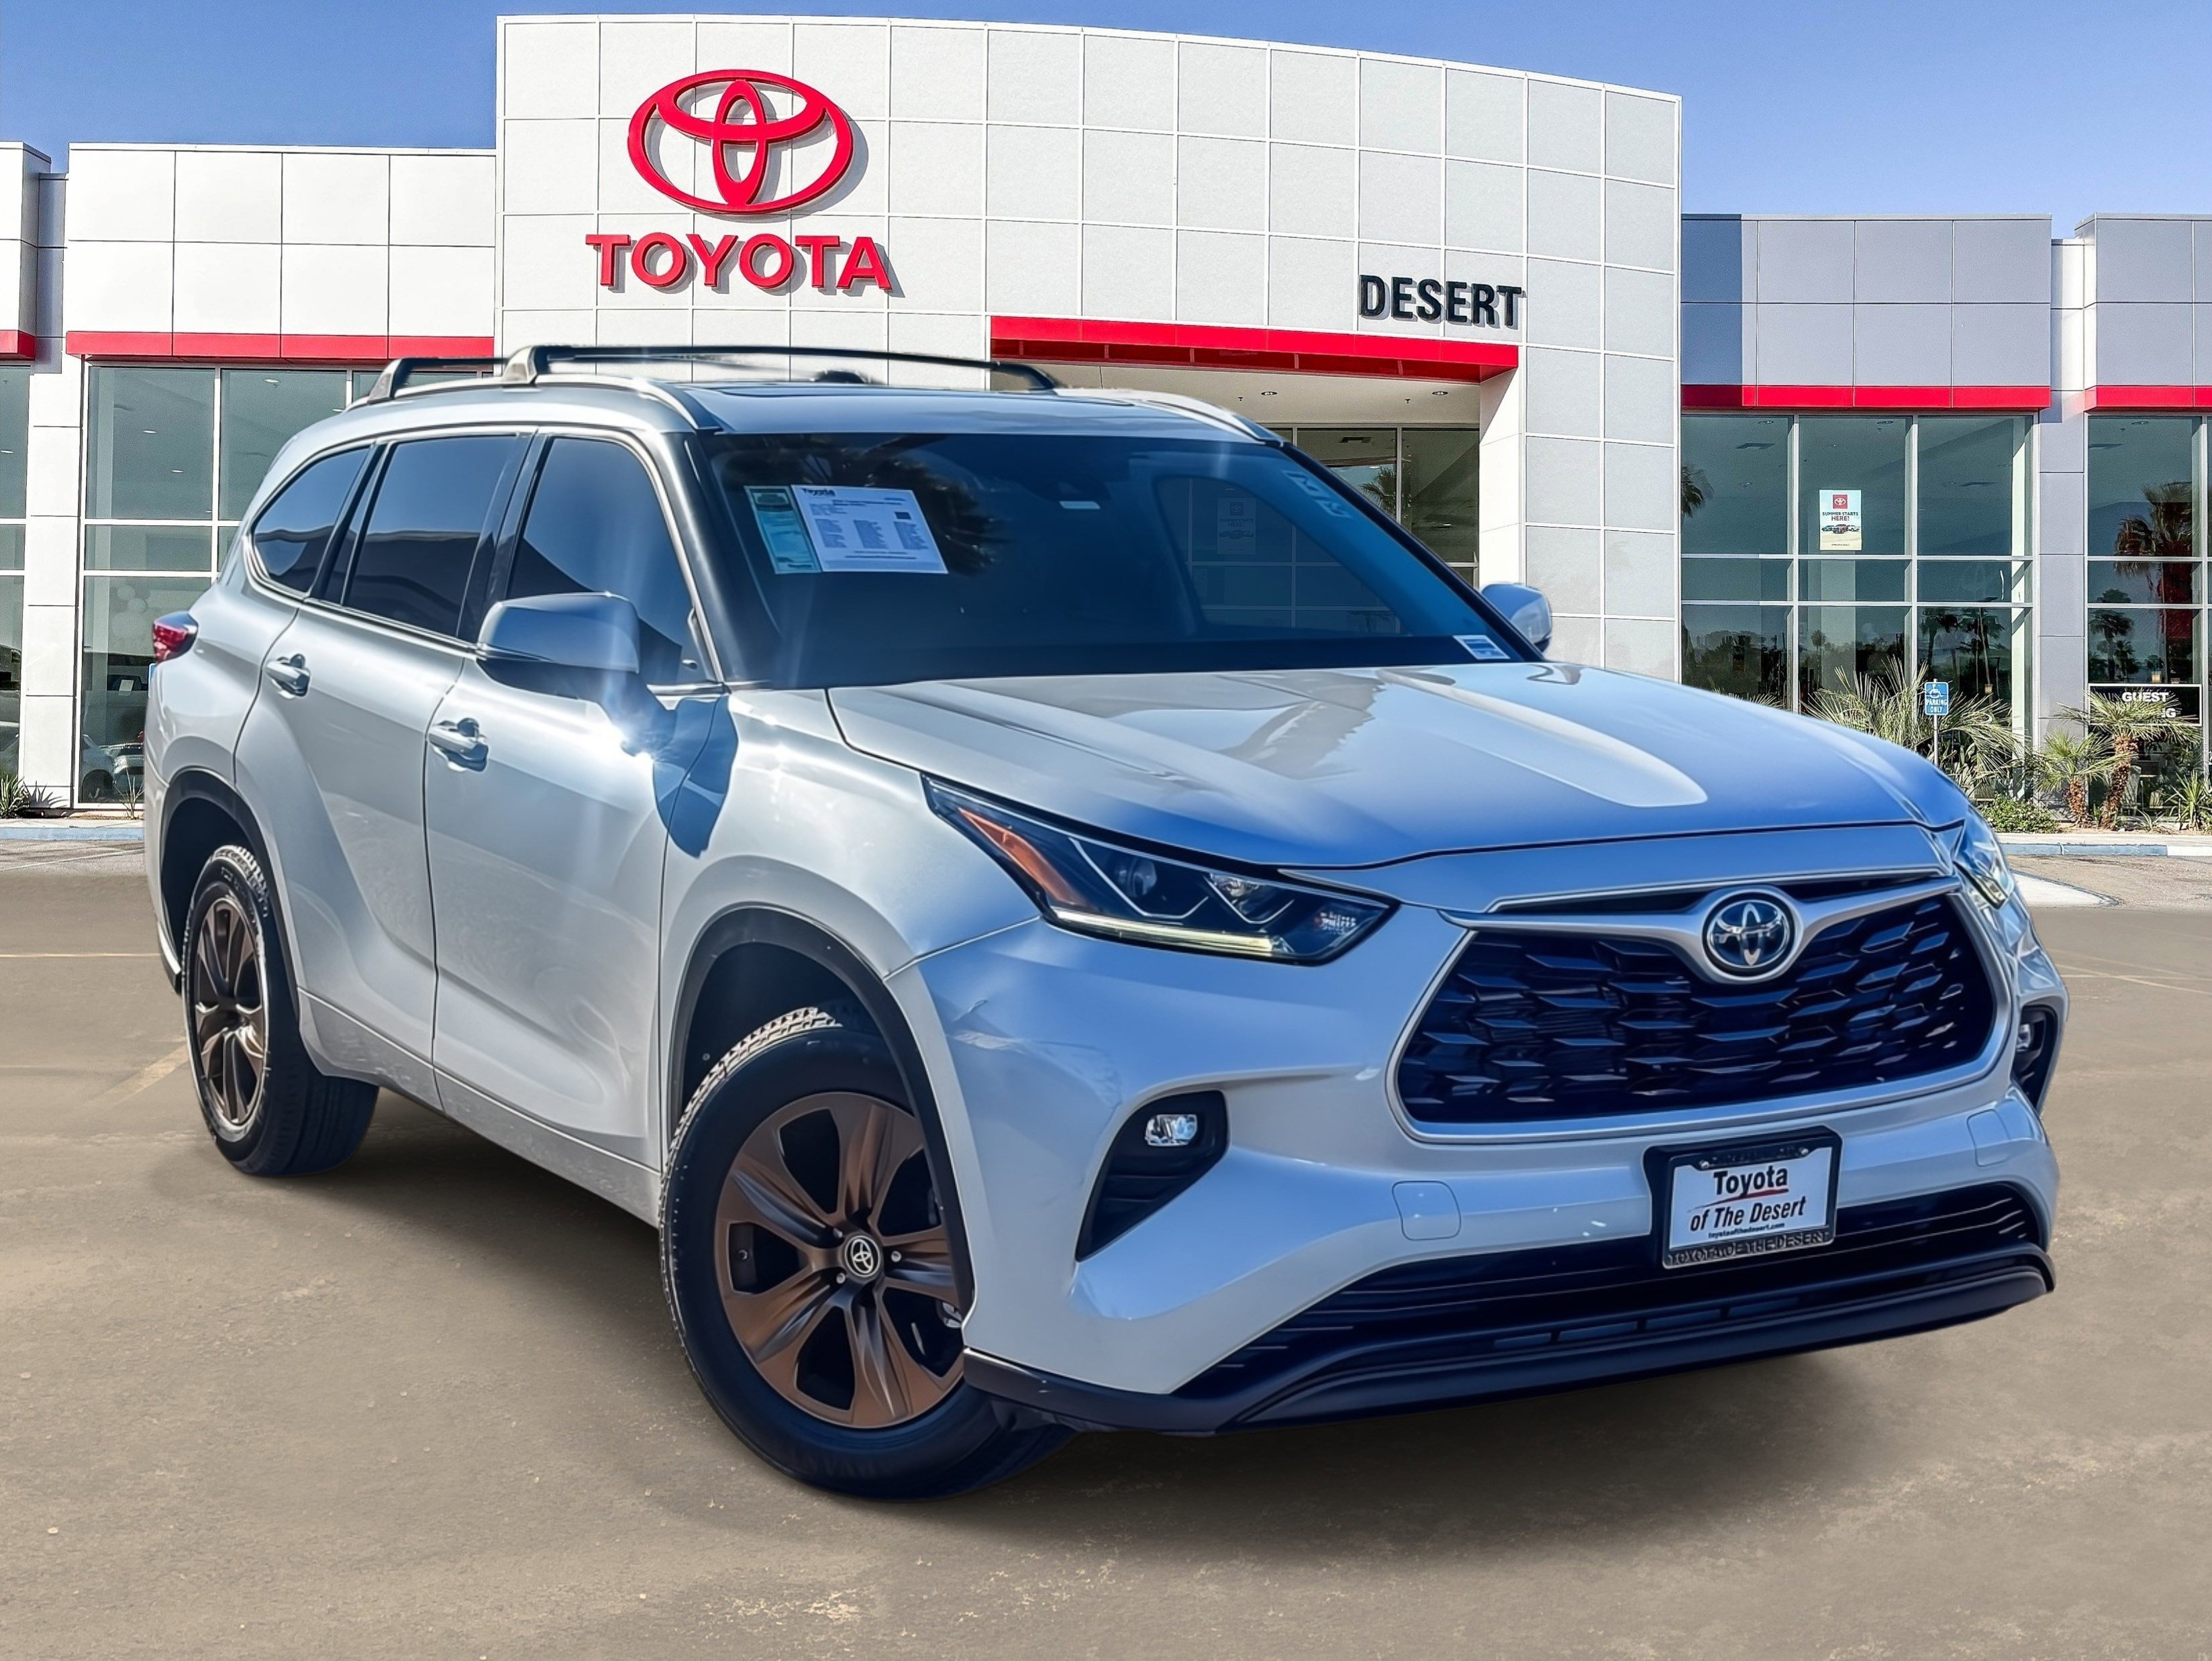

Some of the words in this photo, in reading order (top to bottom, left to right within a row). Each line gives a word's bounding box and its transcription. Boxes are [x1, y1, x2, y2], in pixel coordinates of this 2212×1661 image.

[586, 232, 893, 290] TOYOTA
[1359, 274, 1522, 327] DESERT
[2121, 691, 2170, 703] GUEST
[1713, 1165, 1789, 1197] Toyota
[1690, 1209, 1710, 1231] of
[1713, 1207, 1745, 1229] The
[1750, 1196, 1807, 1223] Desert
[1708, 1222, 1785, 1239] toyotaofthedesert.com
[1748, 1238, 1777, 1254] THE
[1777, 1231, 1830, 1250] DESERT
